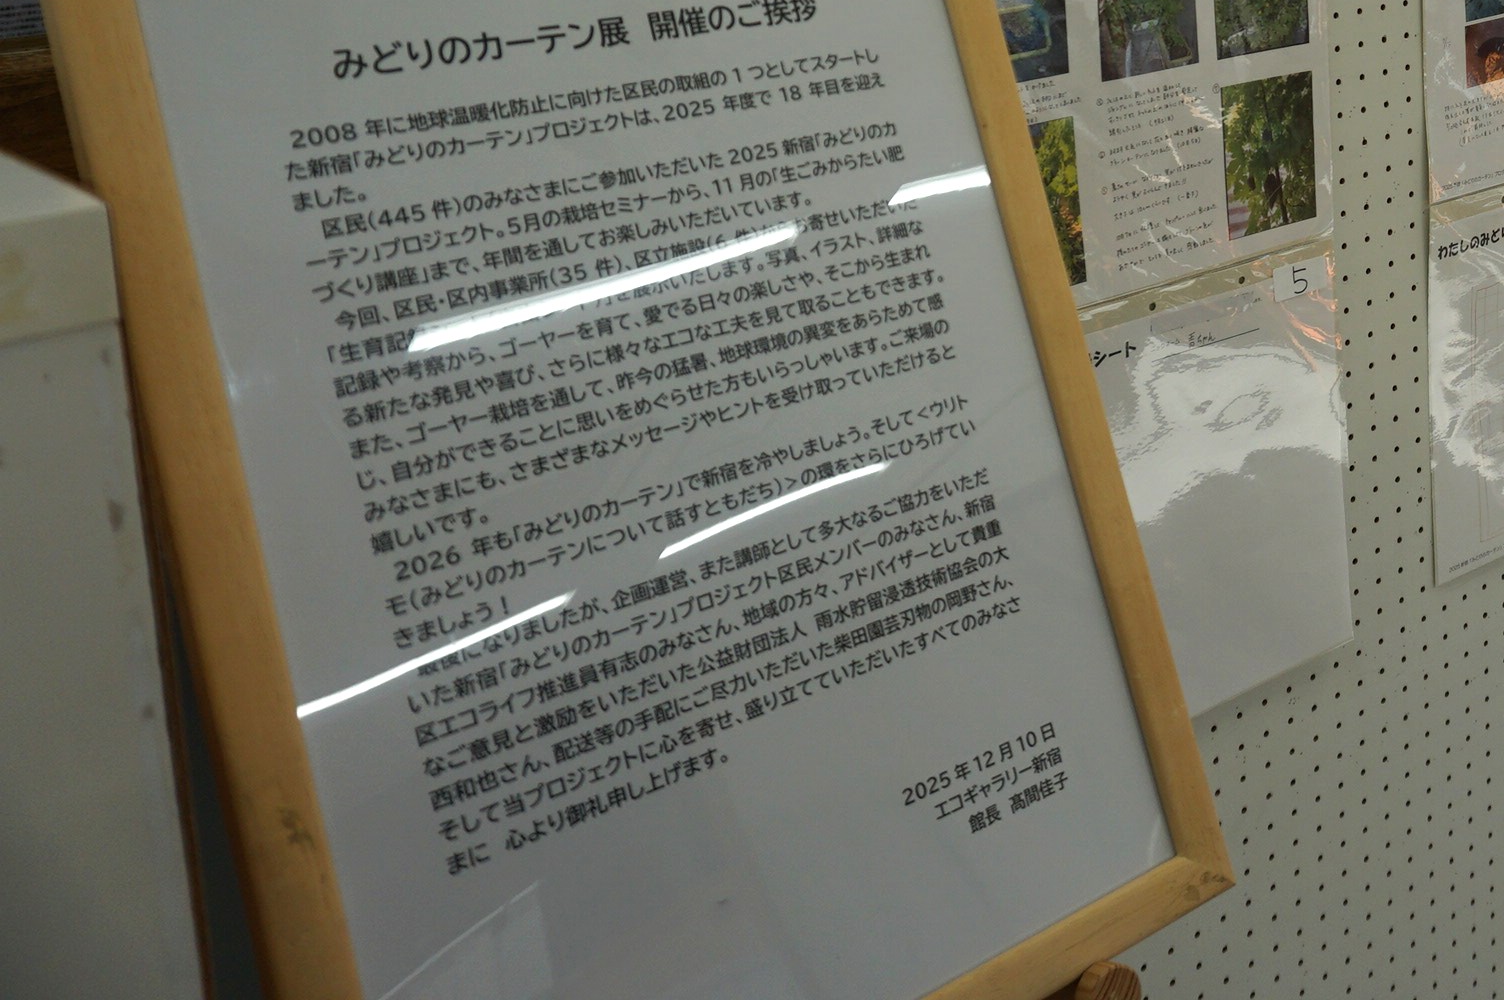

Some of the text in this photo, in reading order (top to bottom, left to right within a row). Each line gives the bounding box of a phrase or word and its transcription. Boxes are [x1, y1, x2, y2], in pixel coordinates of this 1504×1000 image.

[333, 16, 631, 80] みどりのカーテン展
[292, 184, 368, 213] ました。
[1292, 266, 1309, 295] 5
[369, 505, 490, 557] 嬉しいです。
[933, 745, 1064, 822] エコギャラリー新宿
[446, 746, 730, 876] まに 心より御礼申し上げます。
[967, 802, 1003, 835] 館長
